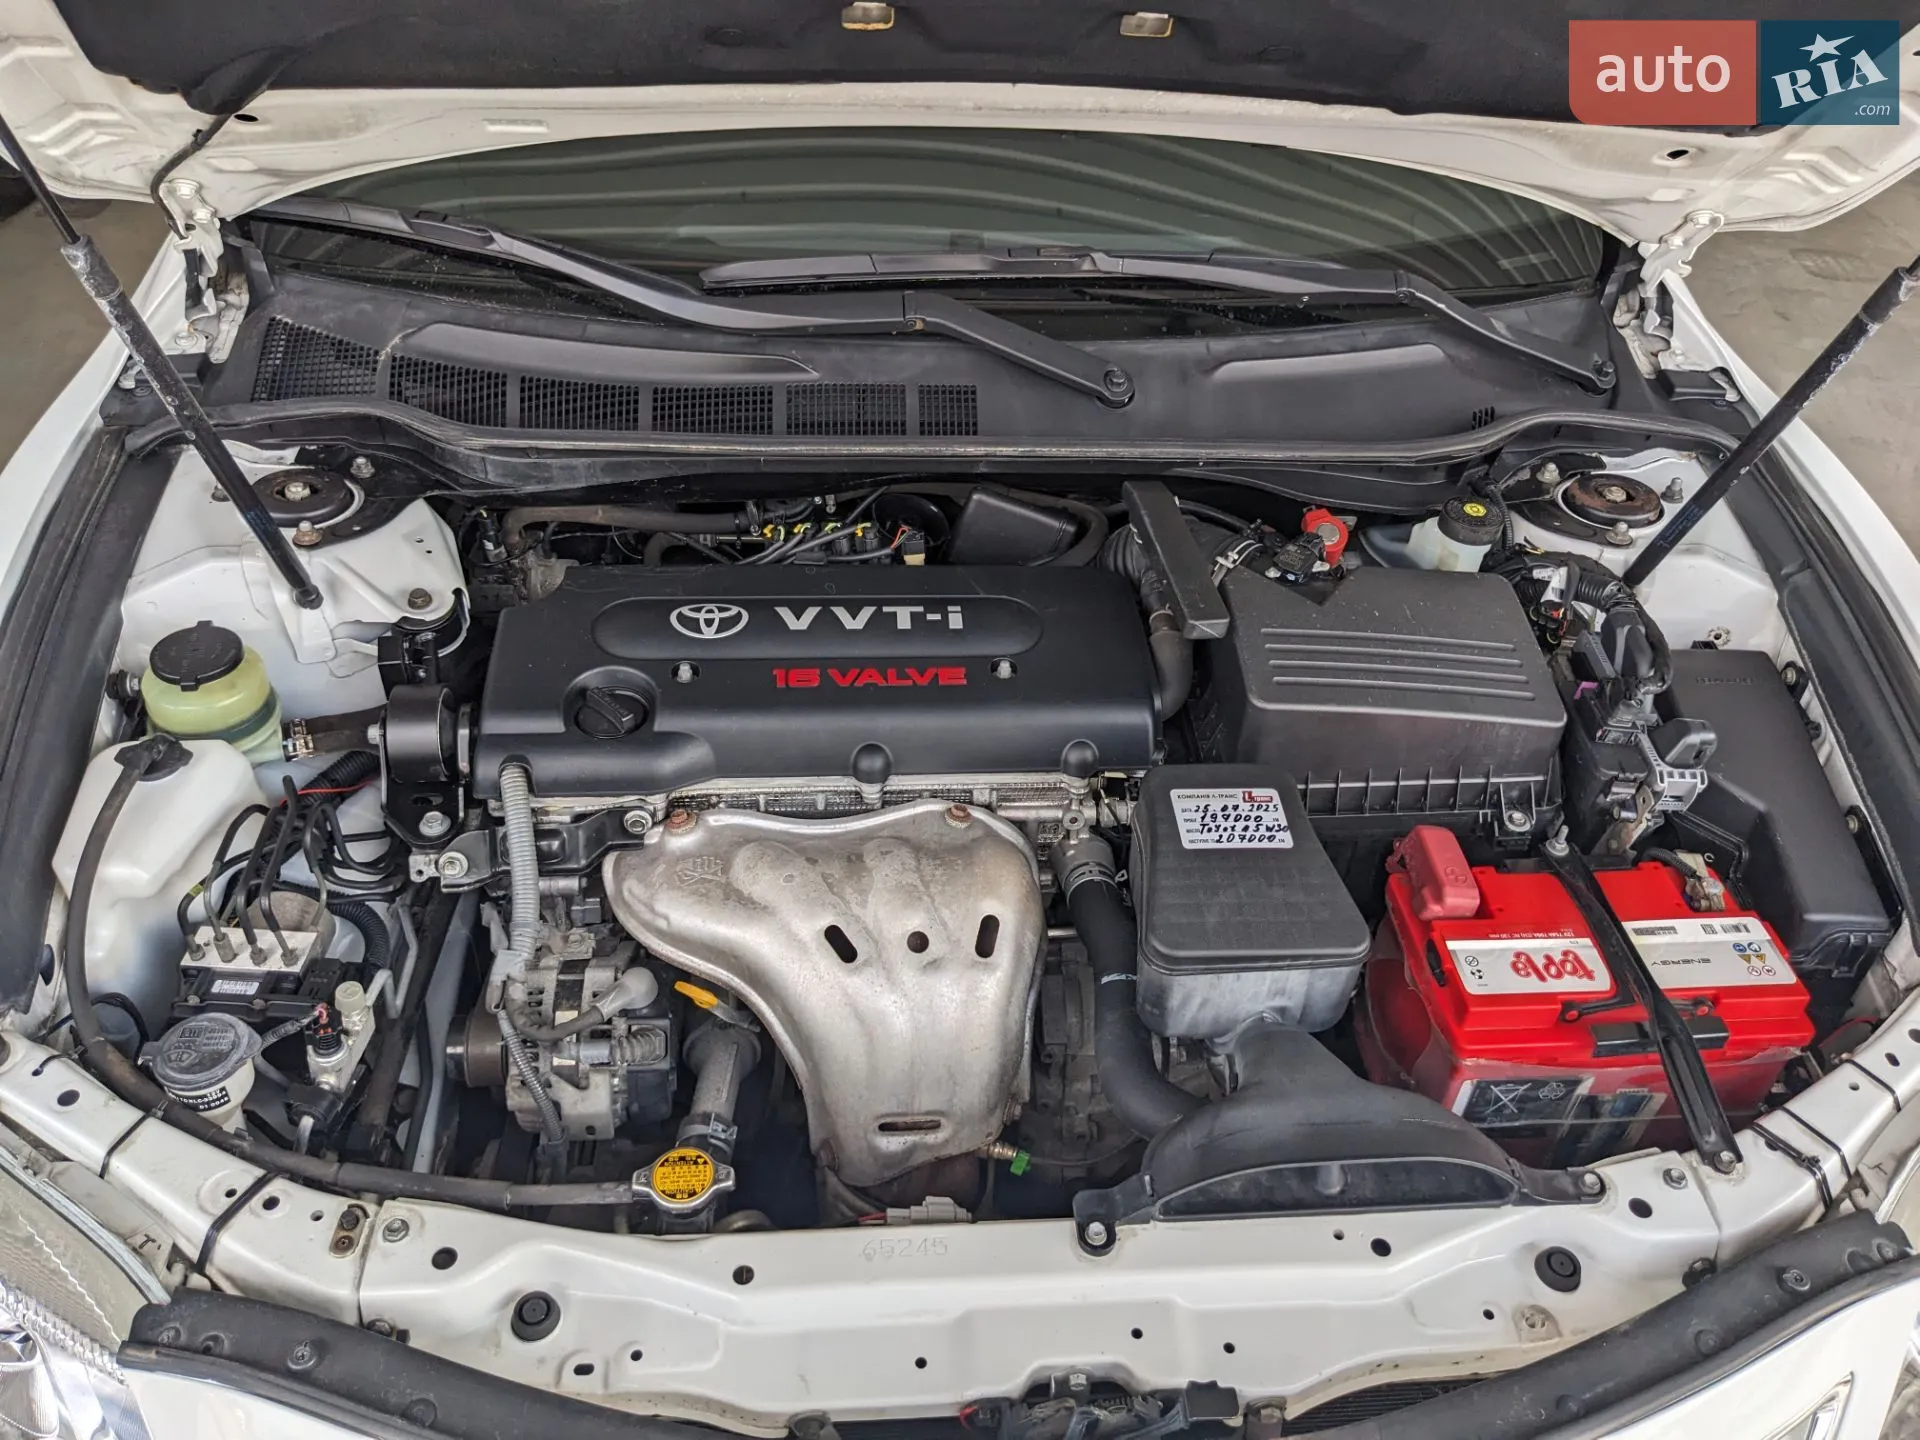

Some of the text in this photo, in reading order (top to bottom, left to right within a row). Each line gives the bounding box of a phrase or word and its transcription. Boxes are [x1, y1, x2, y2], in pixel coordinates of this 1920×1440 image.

[773, 606, 964, 630] VVT-i
[772, 667, 968, 688] 16 VALVE
[1651, 957, 1712, 967] ENERGY
